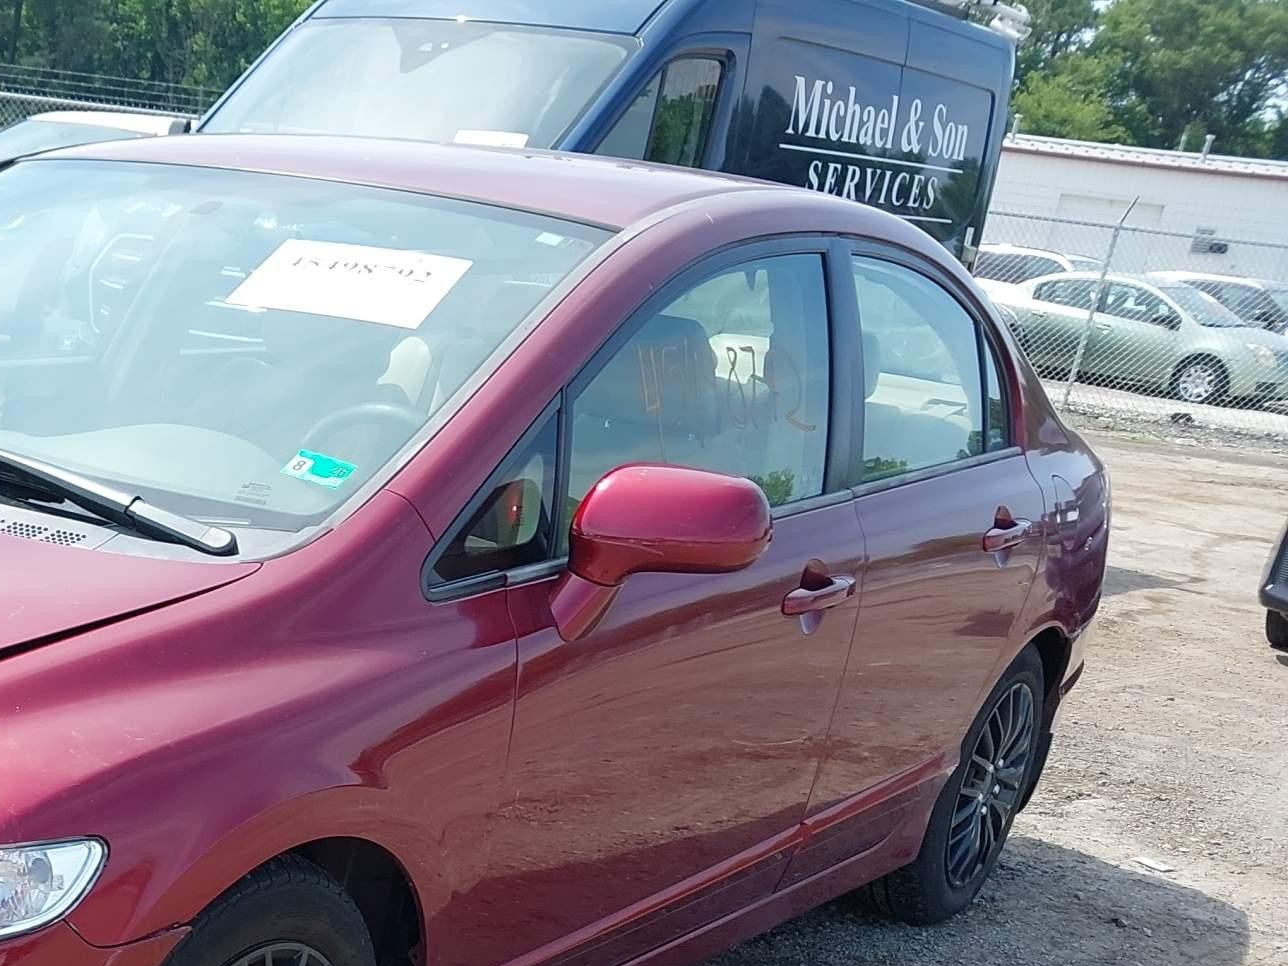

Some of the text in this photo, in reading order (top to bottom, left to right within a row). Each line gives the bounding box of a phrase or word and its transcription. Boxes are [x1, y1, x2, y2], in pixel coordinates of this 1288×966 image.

[785, 75, 968, 160] Michael & Son
[805, 160, 938, 210] SERVICES
[292, 460, 307, 471] 8
